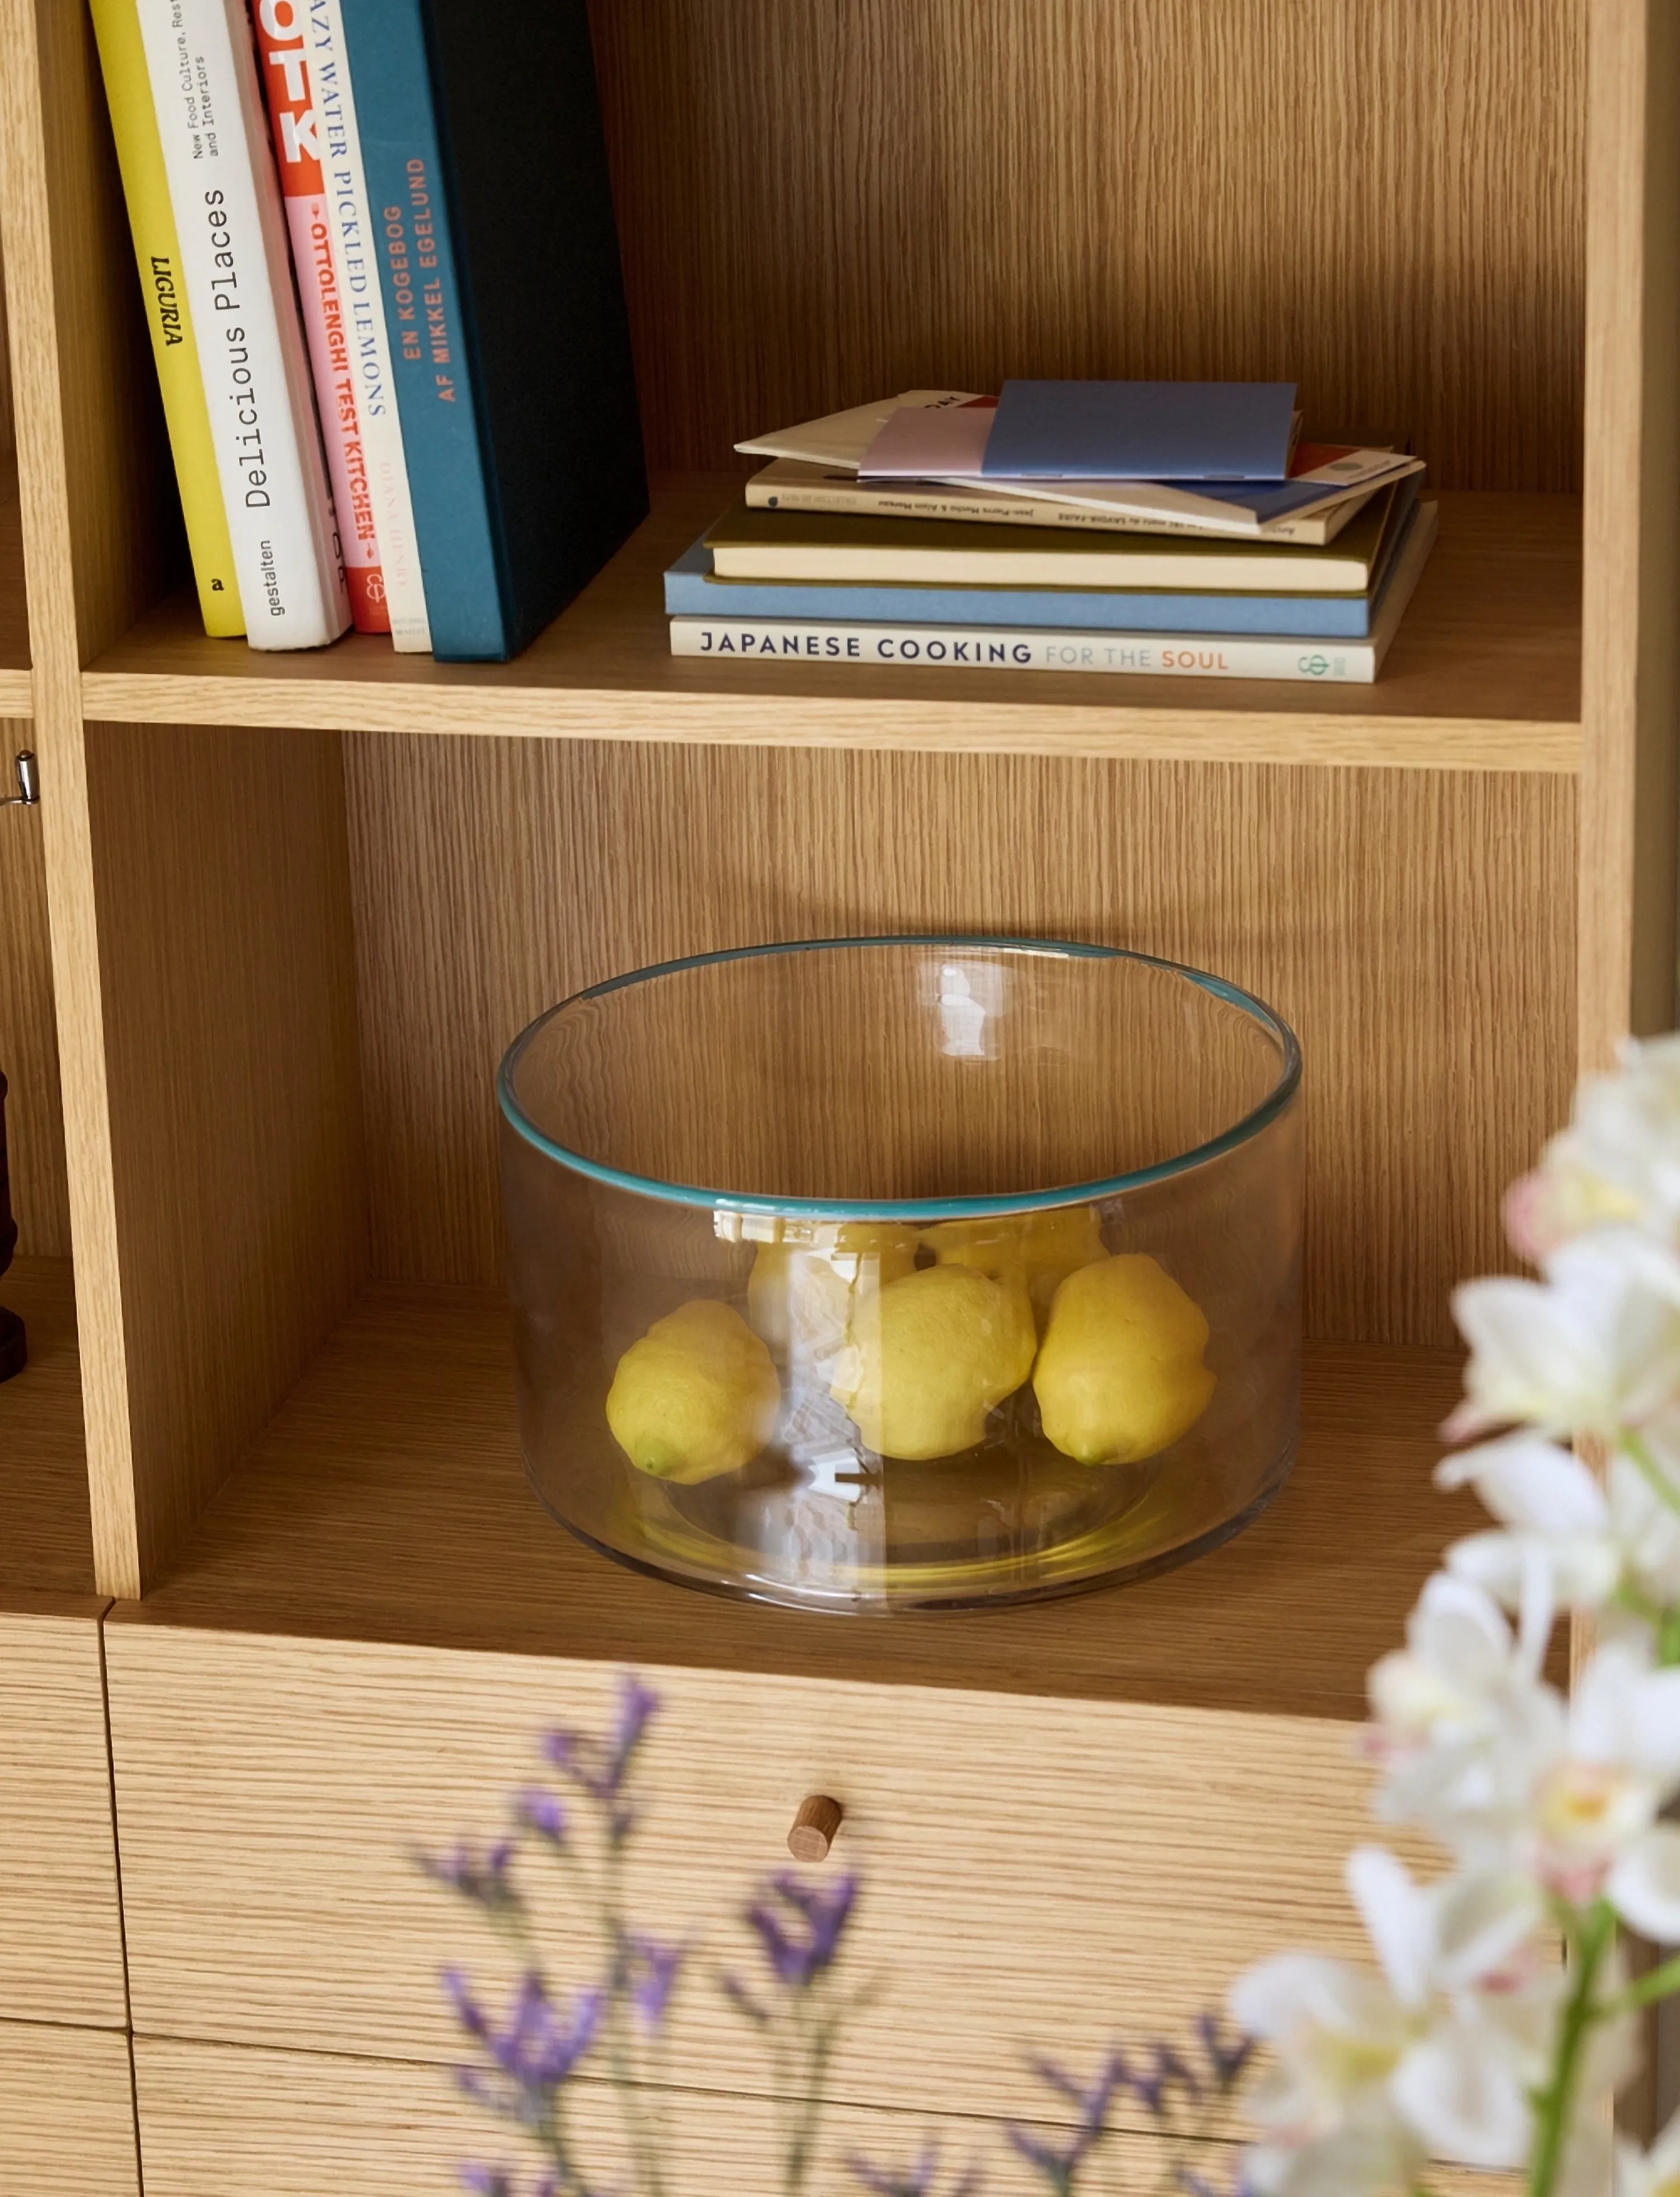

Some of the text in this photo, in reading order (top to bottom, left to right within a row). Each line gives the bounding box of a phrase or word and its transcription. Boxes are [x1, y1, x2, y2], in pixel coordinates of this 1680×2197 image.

[184, 96, 199, 128] Food
[192, 134, 203, 159] New
[195, 56, 218, 157] and Interiors
[319, 62, 347, 158] WATER
[334, 170, 366, 293] PICKLED
[353, 302, 386, 416] LEMONS
[384, 206, 421, 360] EN KOGEBOG
[407, 159, 456, 402] AF MIKKEL EGELUND
[151, 256, 184, 347] LIGURIA
[205, 190, 270, 508] Delicious Places
[310, 223, 375, 541] OTTOLENGHI TEST KITCHEN
[260, 540, 286, 617] gestalten
[379, 462, 409, 588] DIANA HENRY
[700, 632, 1228, 670] JAPANESE COOKING FOR THE SOUL
